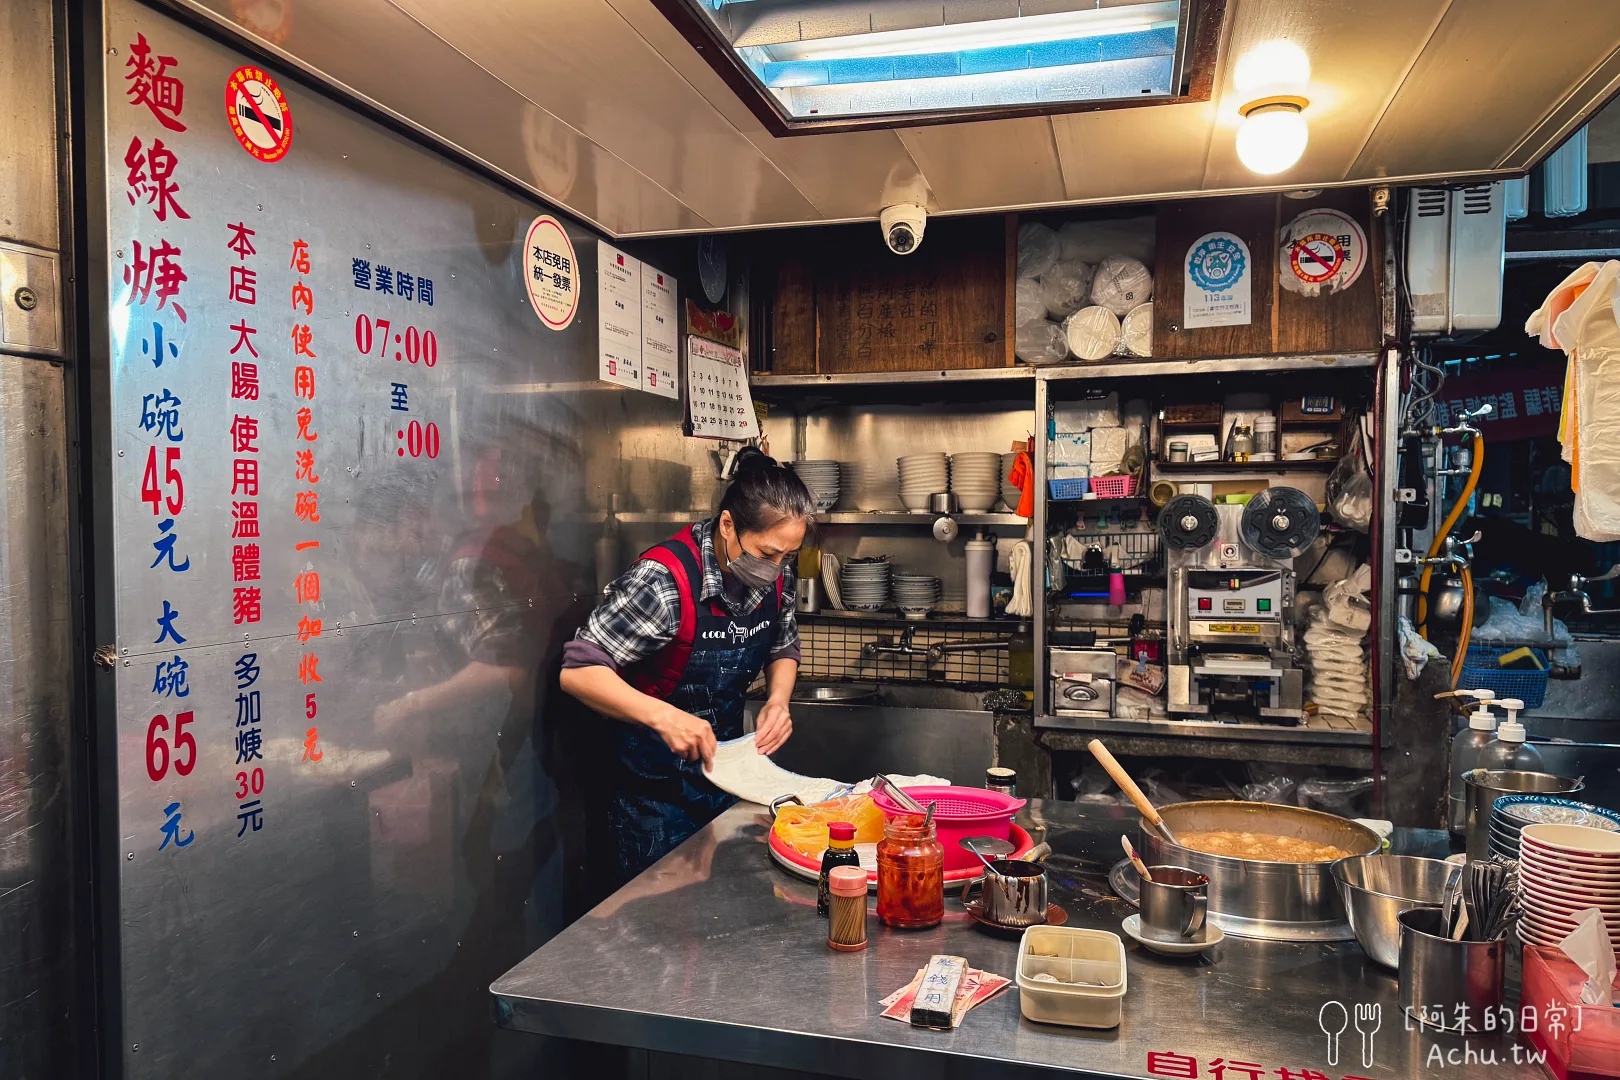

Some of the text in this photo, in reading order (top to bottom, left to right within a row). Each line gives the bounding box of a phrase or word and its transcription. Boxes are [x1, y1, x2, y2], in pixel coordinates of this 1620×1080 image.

[532, 245, 571, 274] 本店免用
[533, 264, 572, 293] 統一發票
[352, 257, 435, 308] 營業時間
[355, 313, 438, 368] 07:00
[390, 382, 410, 412] 至
[227, 221, 262, 627] 本店大腸使用溫體豬
[397, 420, 440, 459] :00
[290, 238, 324, 763] 店內使用免洗碗一個加收5元
[702, 630, 727, 639] COOL
